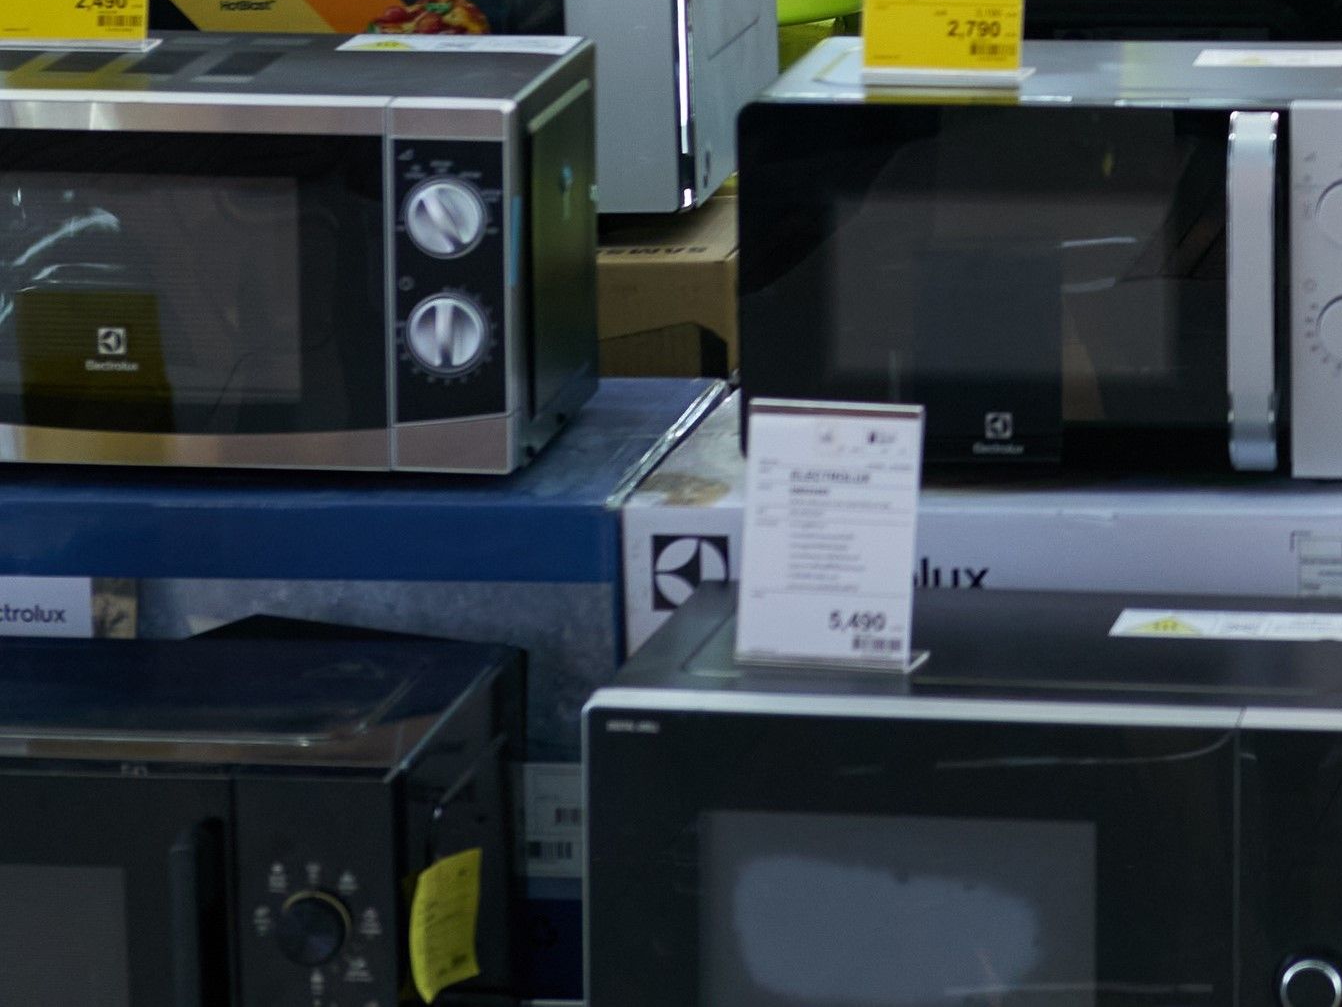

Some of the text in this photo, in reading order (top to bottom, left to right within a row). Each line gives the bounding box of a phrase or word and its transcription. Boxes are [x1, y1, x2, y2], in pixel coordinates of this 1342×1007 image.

[947, 21, 1001, 39] 2,790
[0, 604, 66, 623] trolux
[828, 609, 887, 633] 5,490
